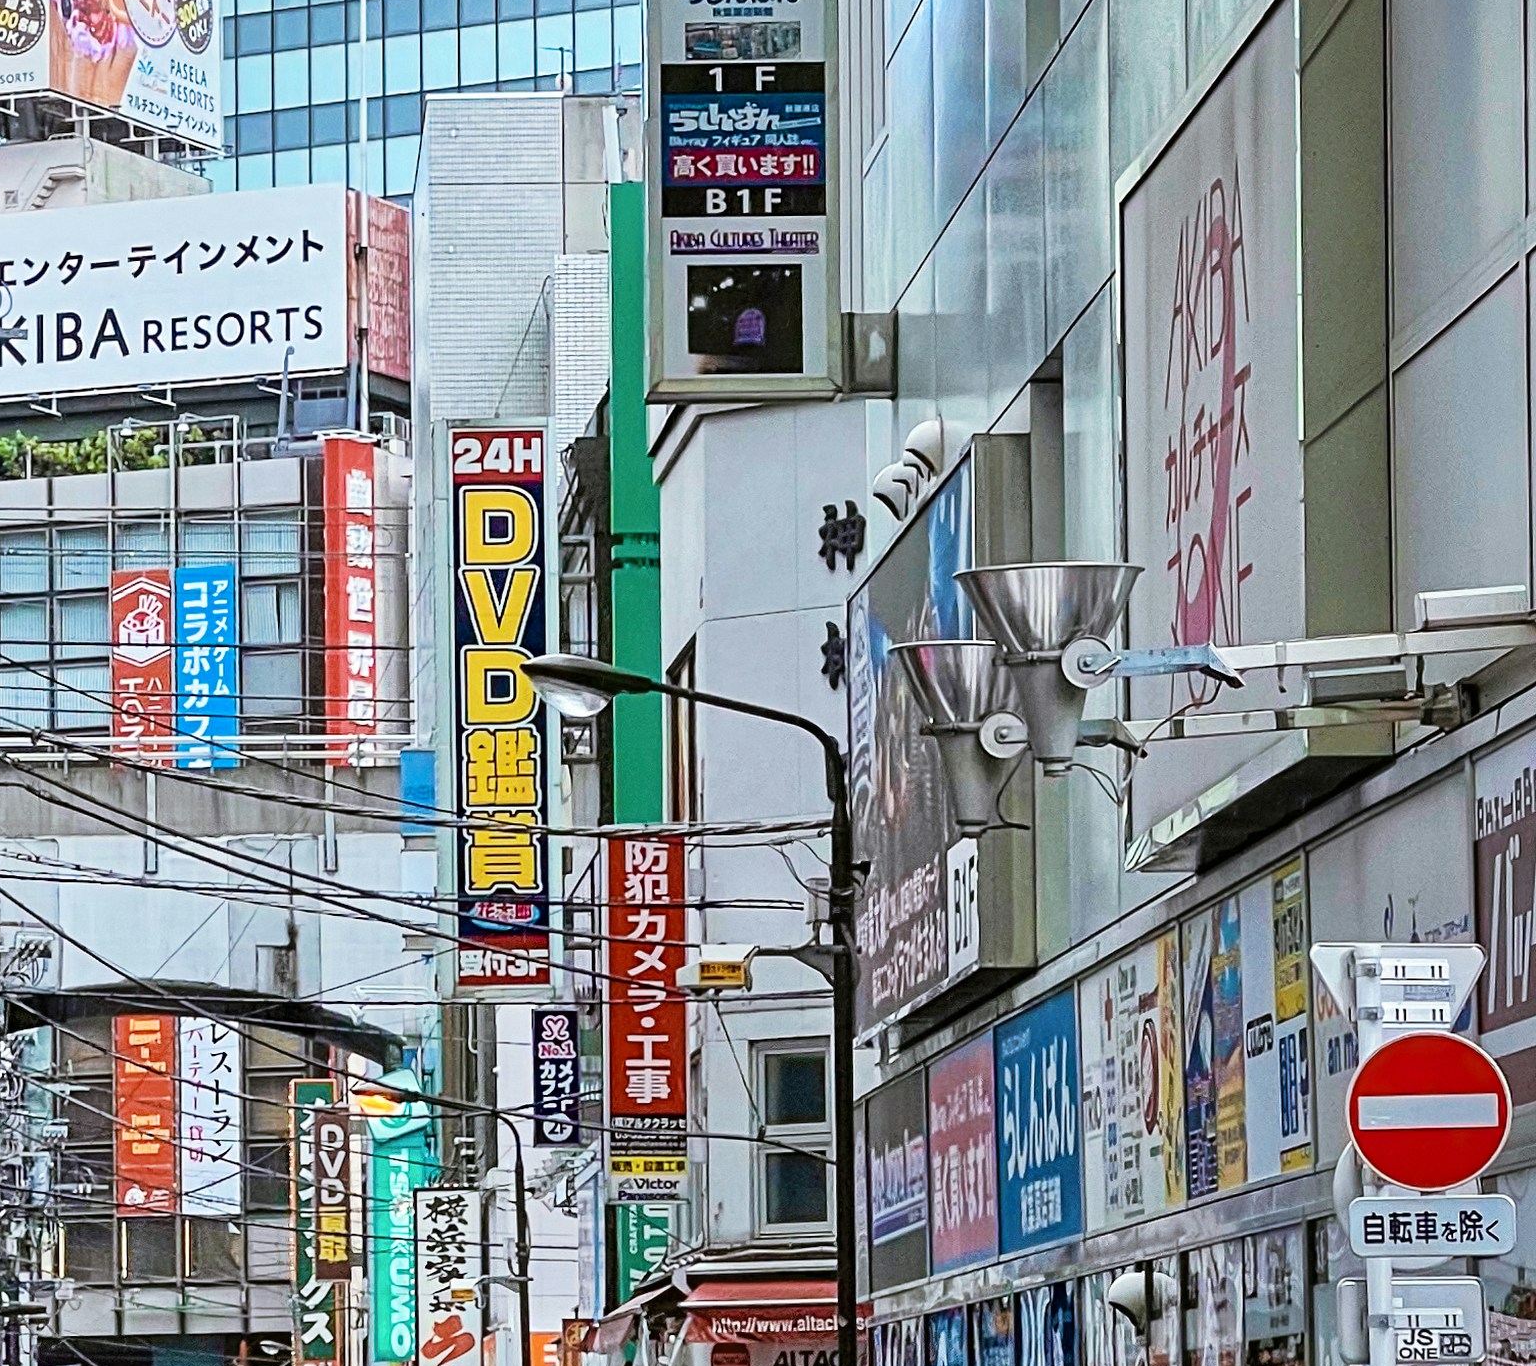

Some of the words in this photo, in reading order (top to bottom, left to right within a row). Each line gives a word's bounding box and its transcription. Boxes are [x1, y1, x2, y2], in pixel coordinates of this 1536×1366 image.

[169, 59, 208, 87] PASELA
[169, 84, 215, 112] RESORTS
[669, 101, 780, 132] らしんばん
[673, 153, 815, 177] 高く買います!!
[142, 305, 324, 355] RESORTS
[453, 438, 542, 475] 24H
[212, 580, 231, 696] アニメ・ゲーム
[624, 840, 672, 1104] 防犯カメラ・工事
[209, 1022, 234, 1163] レストラン
[1001, 1035, 1076, 1182] らしんばん
[634, 1178, 680, 1190] Victor
[1361, 1211, 1499, 1244] 自転車を除く
[1403, 1328, 1434, 1346] JS
[1399, 1347, 1439, 1360] ONE
